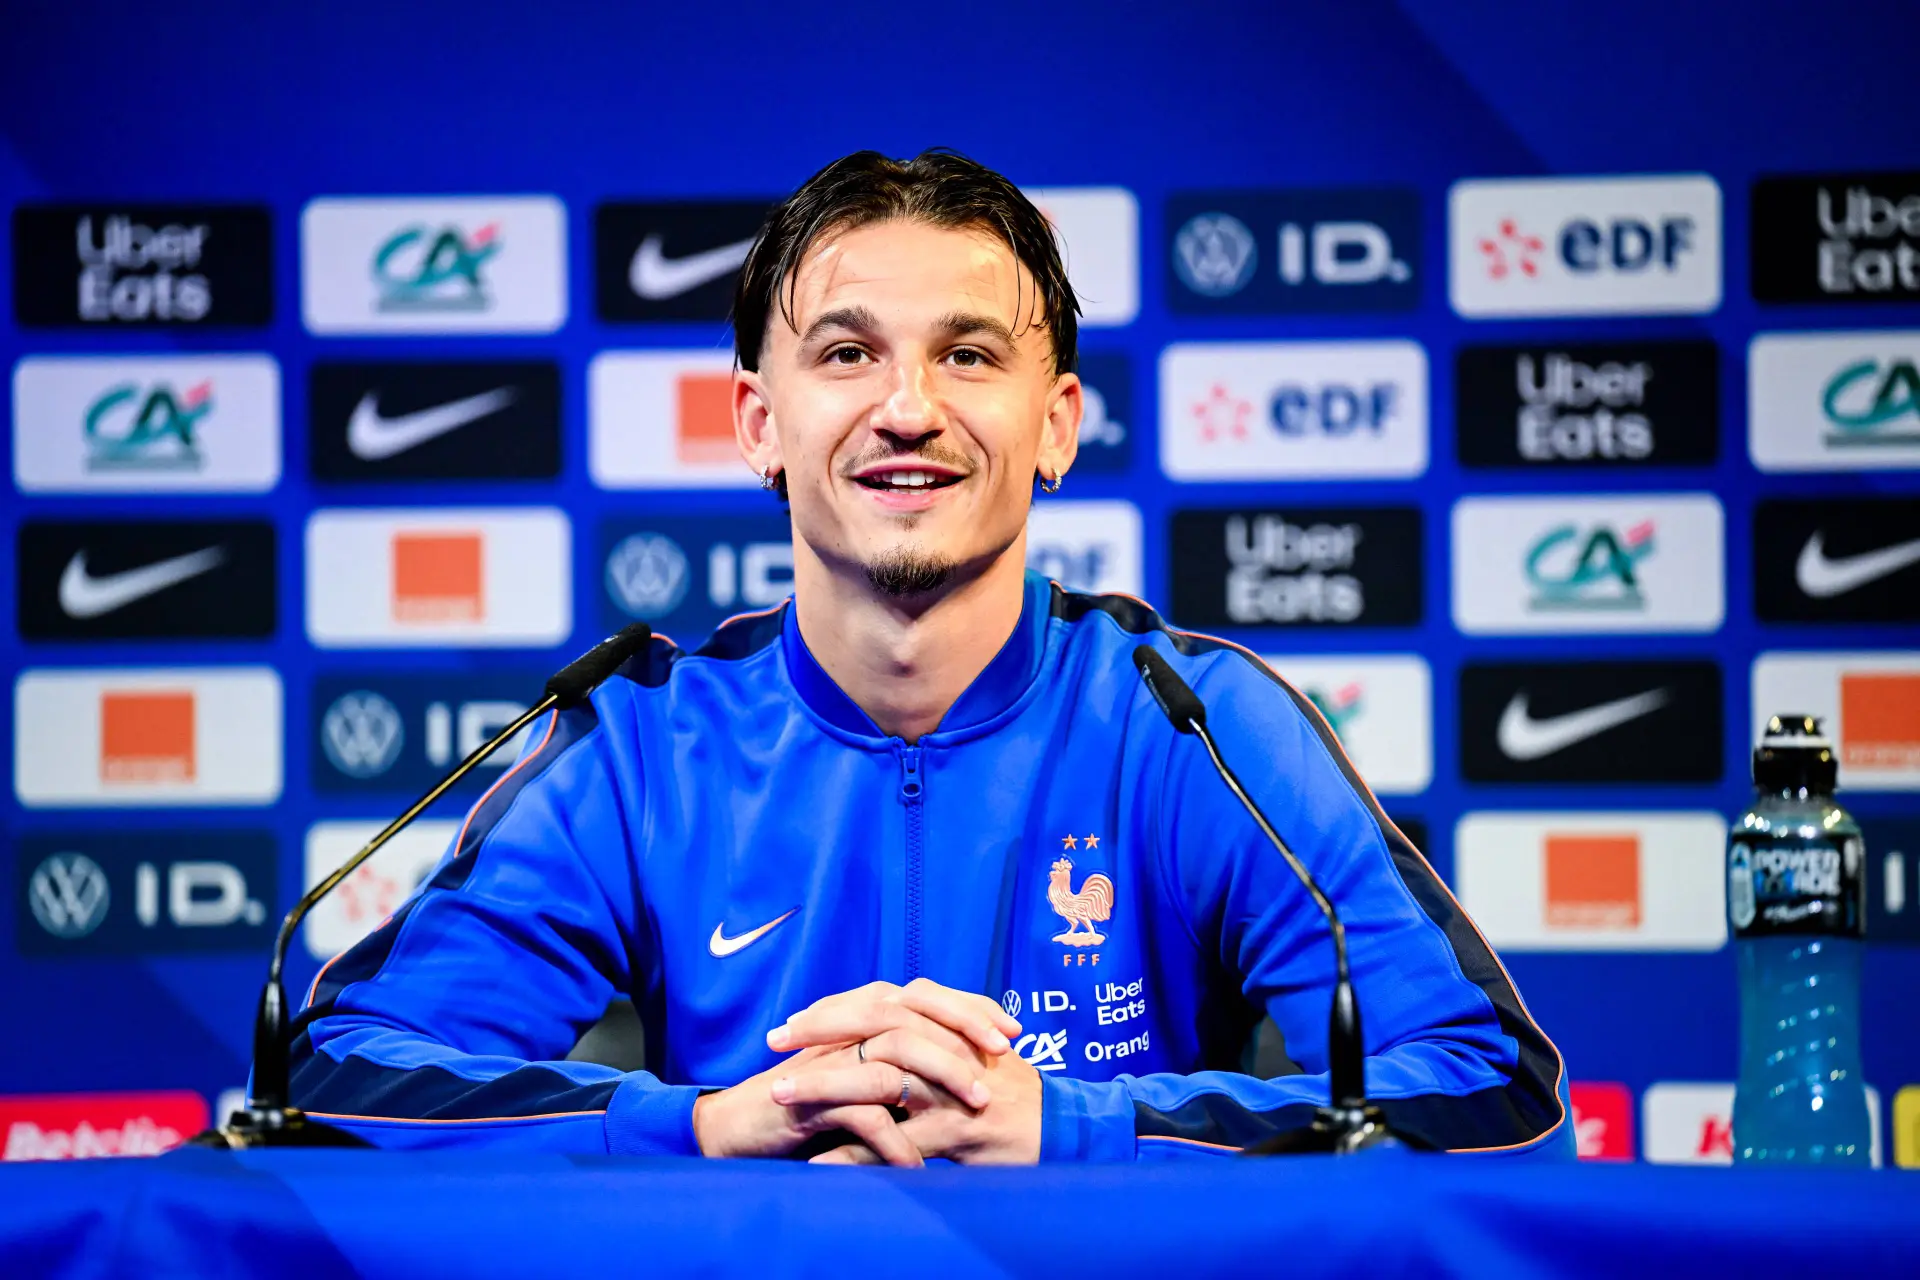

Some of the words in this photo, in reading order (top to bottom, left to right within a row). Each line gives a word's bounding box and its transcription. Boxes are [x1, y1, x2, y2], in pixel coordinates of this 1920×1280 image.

[1817, 186, 1920, 239] Ube
[77, 215, 208, 268] Uber
[1818, 240, 1920, 292] Eat
[77, 266, 211, 320] Eats
[1517, 353, 1654, 407] Uber
[1517, 403, 1653, 460] Eats
[1225, 515, 1361, 572] Uber
[708, 541, 795, 608] ID
[1225, 563, 1363, 623] Eats
[1031, 990, 1077, 1013] ID.
[1095, 977, 1143, 1003] Uber
[1097, 999, 1146, 1025] Eats
[1084, 1030, 1150, 1062] Orang
